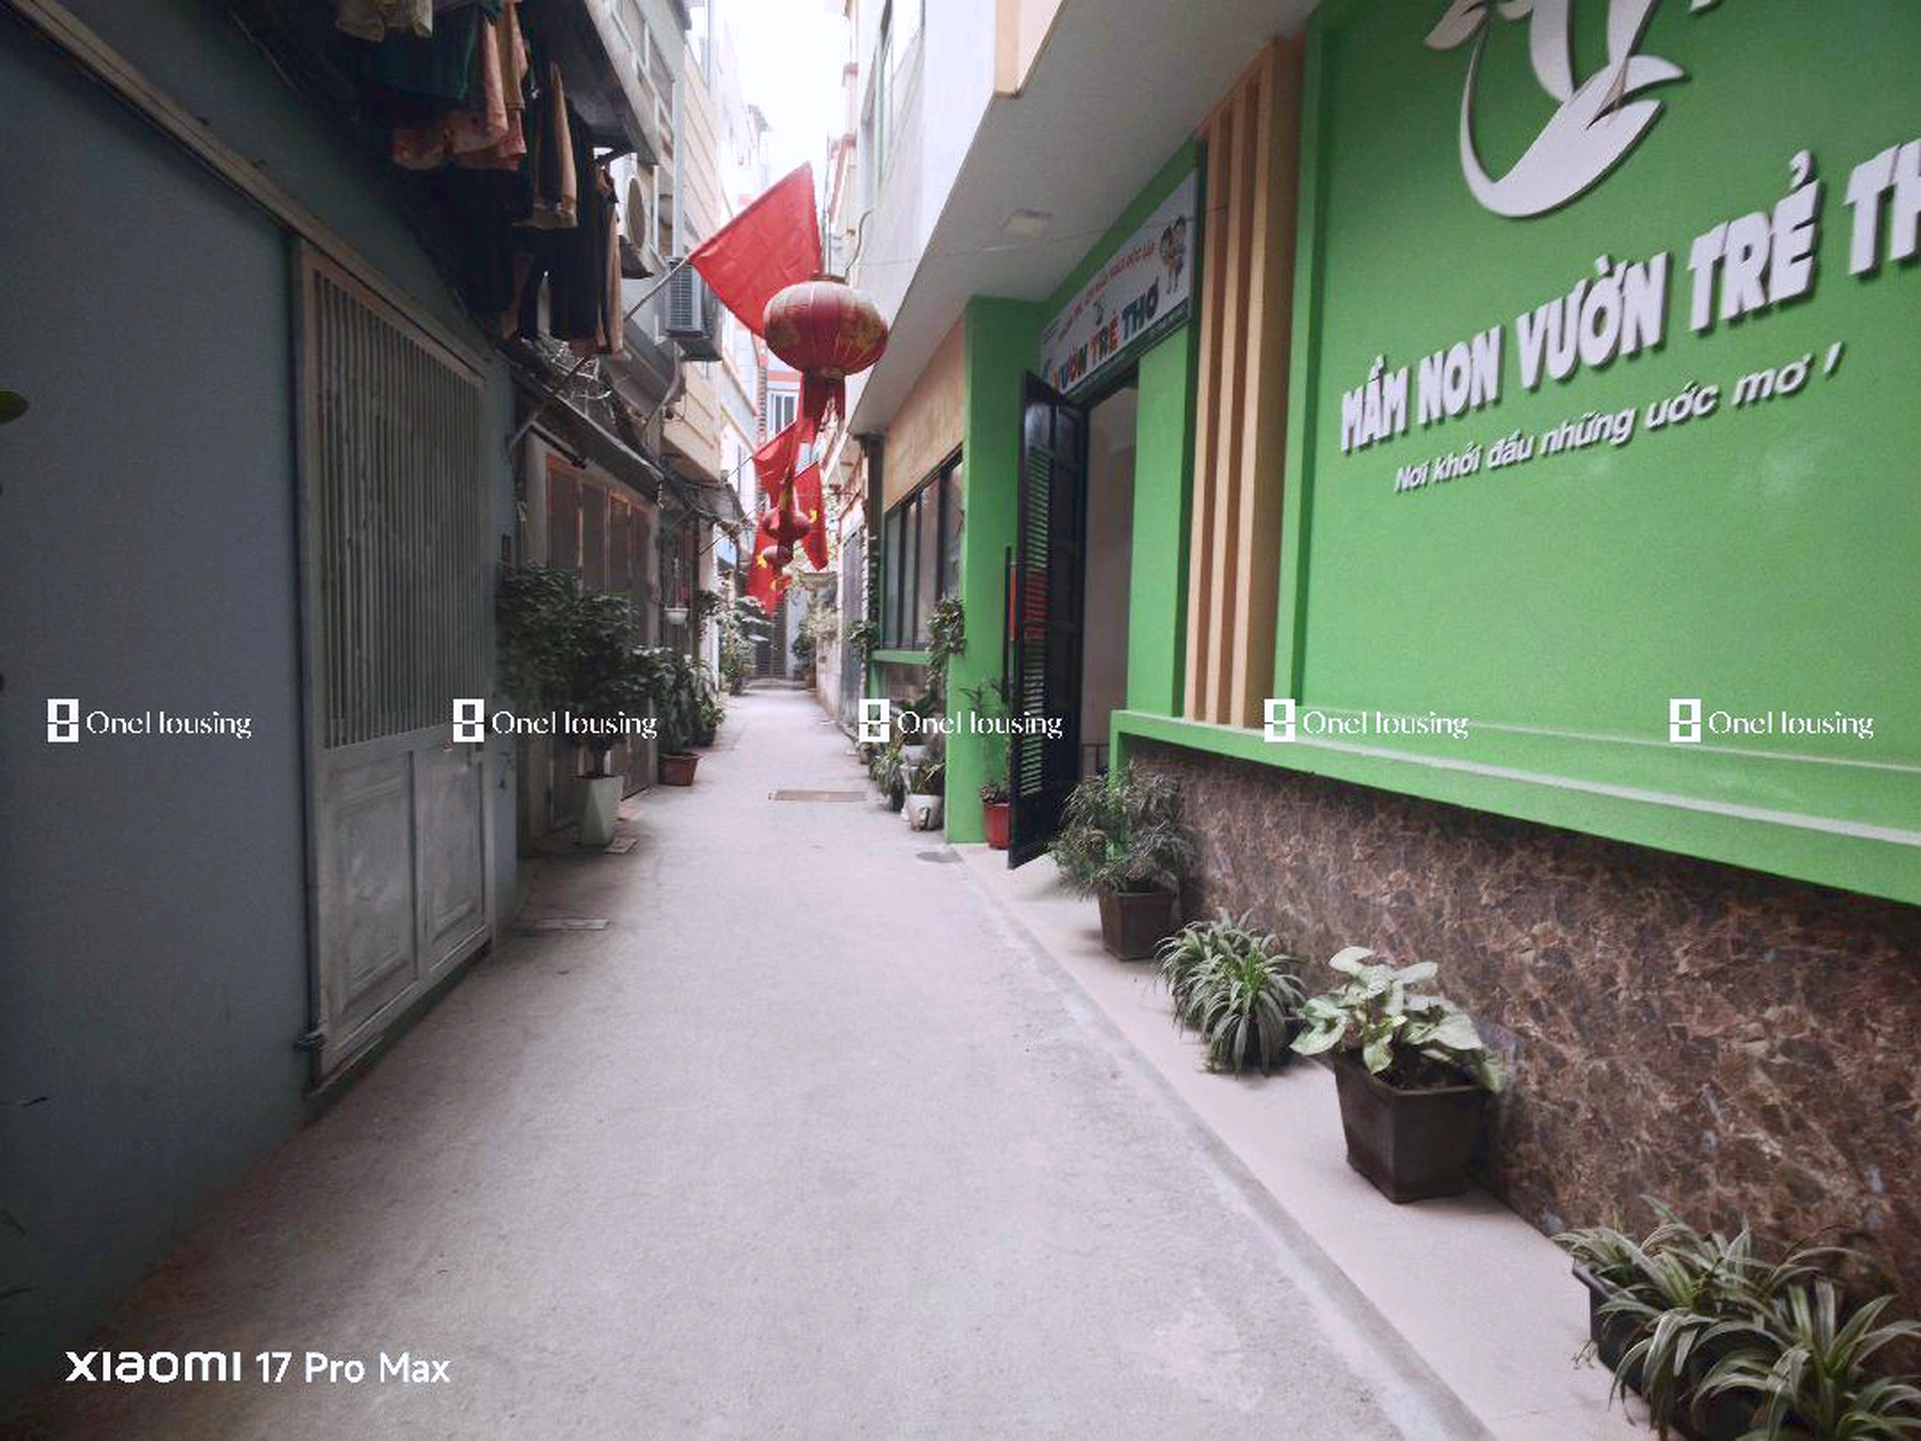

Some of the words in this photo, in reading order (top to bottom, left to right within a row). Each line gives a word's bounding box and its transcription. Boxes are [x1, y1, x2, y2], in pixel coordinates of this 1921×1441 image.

[1418, 325, 1501, 425] NON
[1516, 251, 1668, 389] VƯỜN
[1688, 150, 1820, 331] TRẺ
[1539, 407, 1637, 455] những
[1731, 353, 1814, 406] mơ
